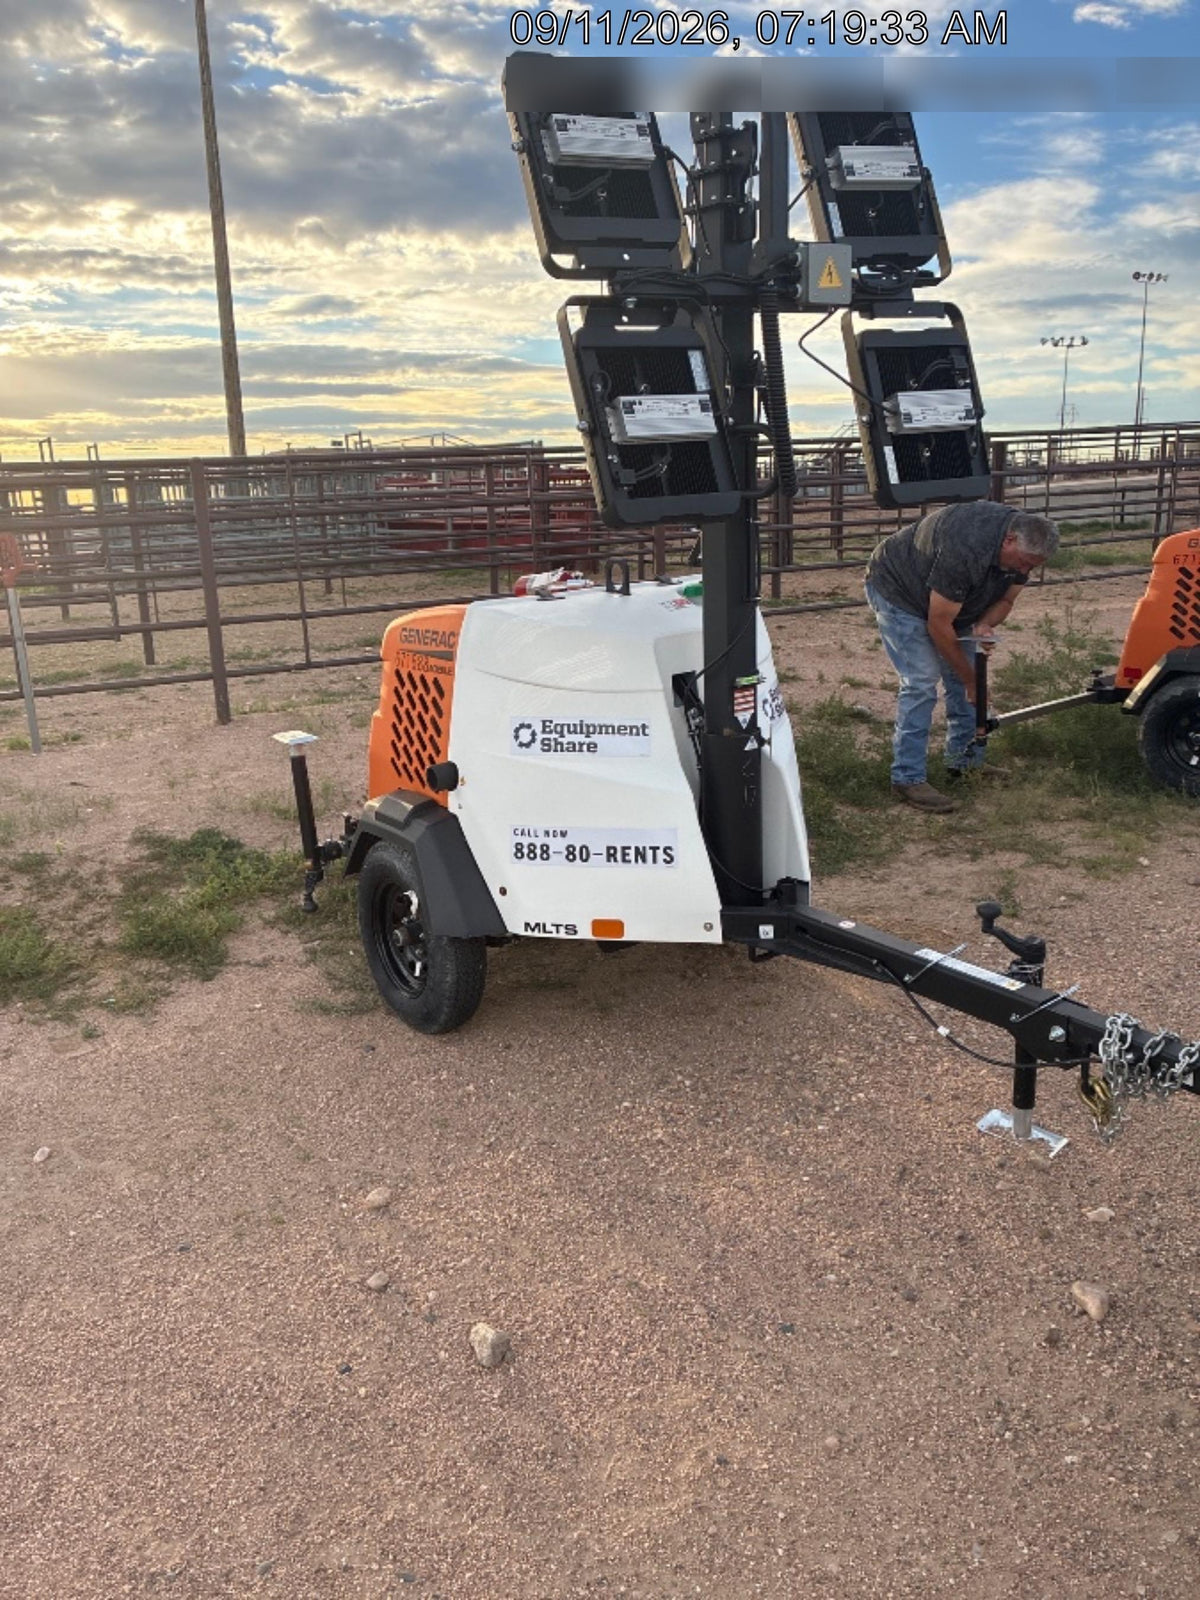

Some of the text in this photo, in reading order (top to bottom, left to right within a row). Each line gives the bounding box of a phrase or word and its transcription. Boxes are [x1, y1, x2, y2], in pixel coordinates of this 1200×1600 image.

[1173, 554, 1200, 565] 671
[400, 627, 456, 649] GENERAC
[541, 719, 649, 738] Equipment
[540, 737, 598, 752] Share
[513, 828, 568, 838] CALL NOW
[513, 842, 675, 865] 888-80-RENTS
[524, 922, 578, 936] MLTS
